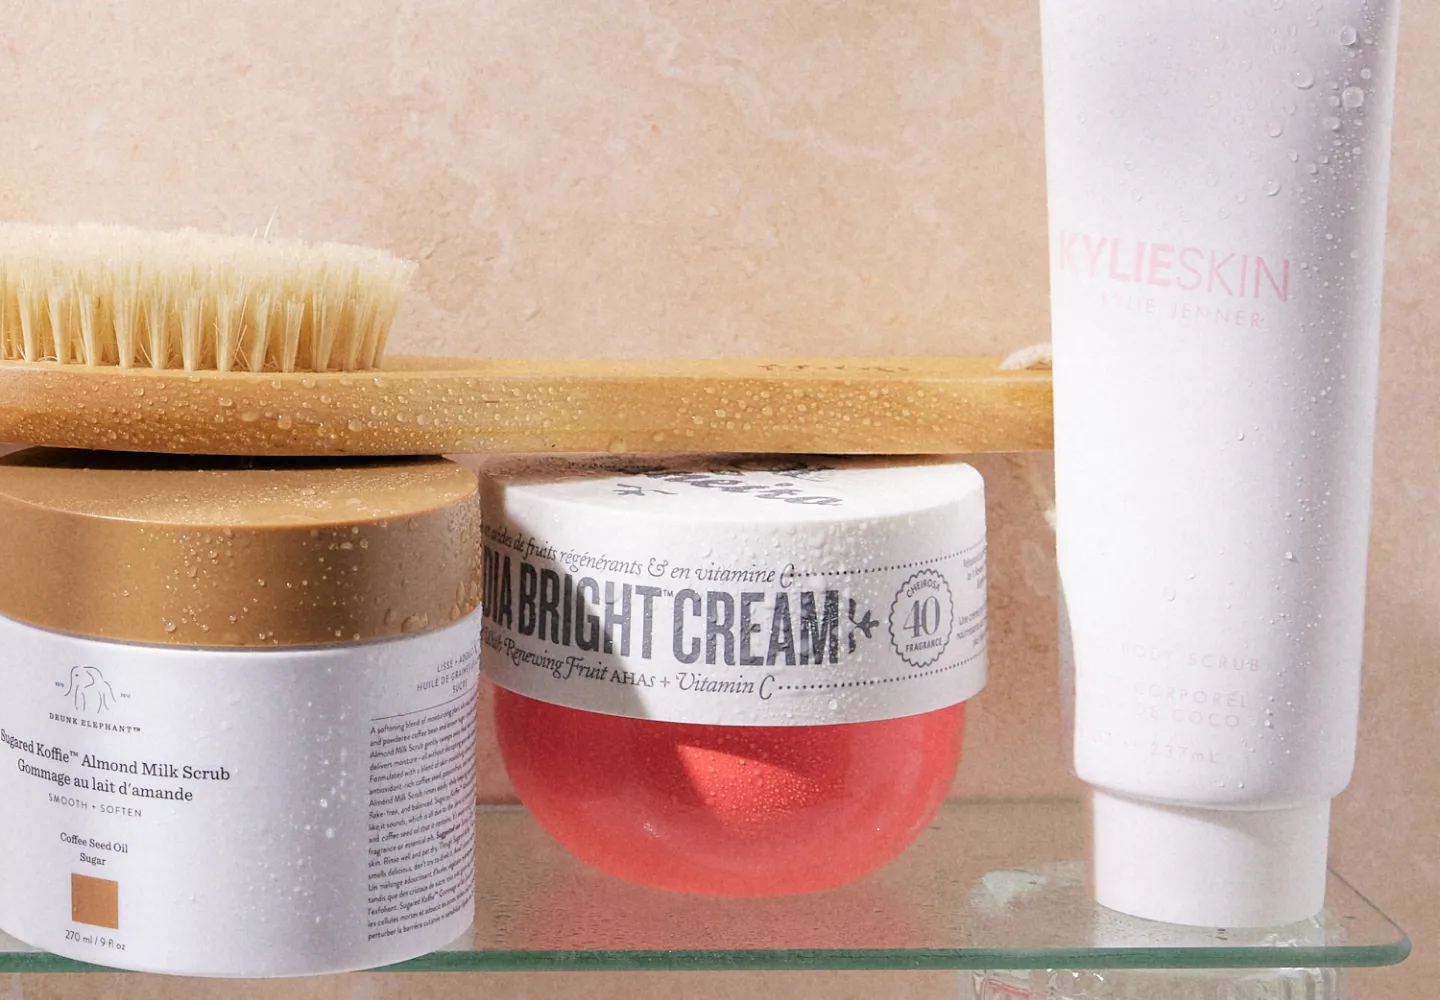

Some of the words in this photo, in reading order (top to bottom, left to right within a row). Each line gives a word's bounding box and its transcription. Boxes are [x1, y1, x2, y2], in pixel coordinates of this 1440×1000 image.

[1060, 230, 1290, 303] KYLIESKIN
[1170, 303, 1261, 328] JENNER
[514, 533, 525, 552] de
[522, 537, 557, 560] fruits
[560, 549, 643, 574] régénérants
[648, 557, 668, 577] &
[670, 566, 690, 579] en
[695, 562, 775, 583] vitamine
[779, 563, 794, 588] C
[906, 579, 941, 598] CHEIROSA
[672, 588, 840, 667] CREAM
[903, 596, 941, 638] 40
[905, 637, 942, 653] FRAGRANCE
[503, 637, 563, 679] Renewing
[562, 656, 609, 680] Fruit
[676, 673, 754, 694] Vitamin
[759, 675, 775, 700] C
[1187, 651, 1261, 672] SCRUB
[1133, 682, 1248, 708] CORPOREL
[49, 712, 78, 725] DRUNK
[1173, 708, 1240, 728] COCO
[1, 729, 34, 755] Sugared
[82, 754, 138, 776] Almond
[142, 762, 179, 779] Milk
[182, 766, 230, 781] Scrub
[17, 758, 71, 786] Gommage
[74, 777, 90, 790] au
[92, 778, 116, 793] lait
[48, 793, 88, 810] SMOOTH
[100, 803, 142, 818] SOFTEN
[60, 832, 88, 847] Coffee
[89, 838, 112, 852] Seed
[113, 842, 128, 854] Oil
[79, 852, 107, 867] Sugar
[65, 929, 81, 942] 270
[83, 933, 93, 944] ml
[100, 937, 106, 947] 9
[108, 937, 115, 948] fl
[116, 943, 126, 951] oz
